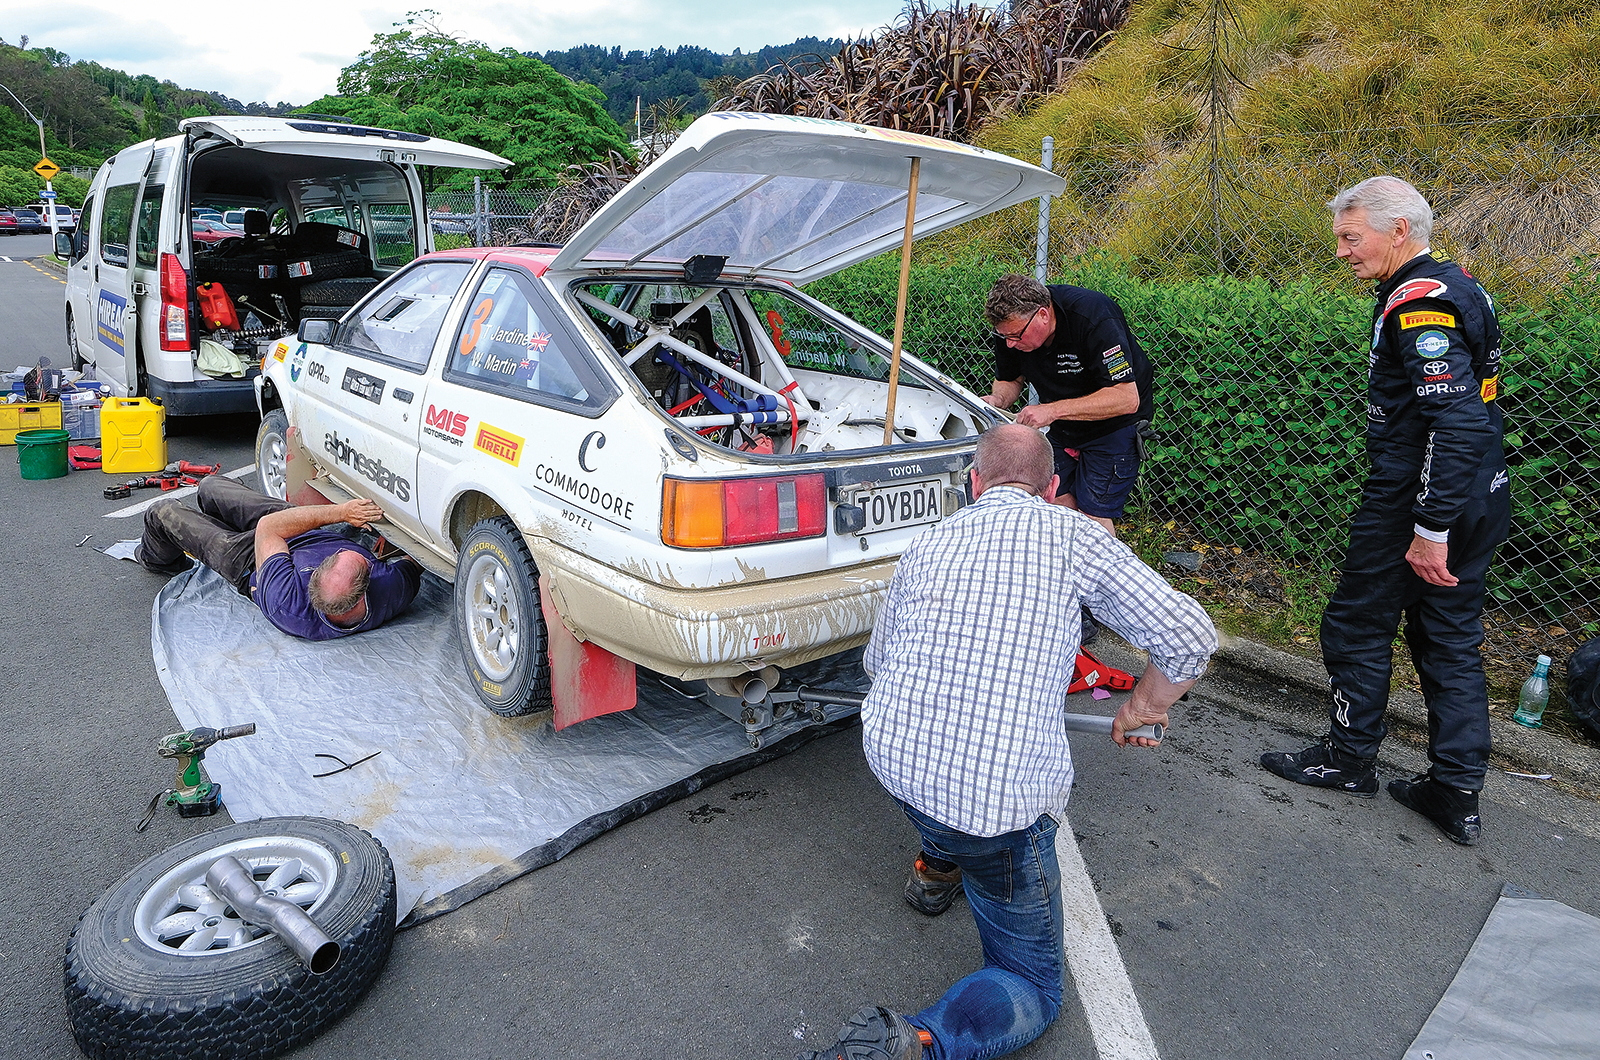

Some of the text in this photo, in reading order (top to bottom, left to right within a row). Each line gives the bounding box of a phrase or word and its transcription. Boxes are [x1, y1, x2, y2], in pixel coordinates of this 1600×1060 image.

[460, 298, 494, 356] 3
[1405, 314, 1449, 325] PIRELLI
[490, 326, 529, 347] Jardine
[1416, 340, 1448, 348] NET-HERO
[471, 351, 518, 375] W. Martin
[1423, 373, 1453, 382] TOYOTA
[1416, 383, 1449, 396] QPR
[425, 404, 469, 437] MIS
[423, 427, 464, 447] MOTORSPORT
[477, 429, 518, 461] PIRELLI
[324, 430, 411, 503] alpinestars
[888, 464, 923, 477] TOYOTA
[535, 463, 634, 520] COMMODORE
[858, 487, 939, 528] TOYBDA
[561, 509, 592, 531] HOTEL
[469, 542, 510, 566] SCORPION
[753, 632, 786, 649] TOW
